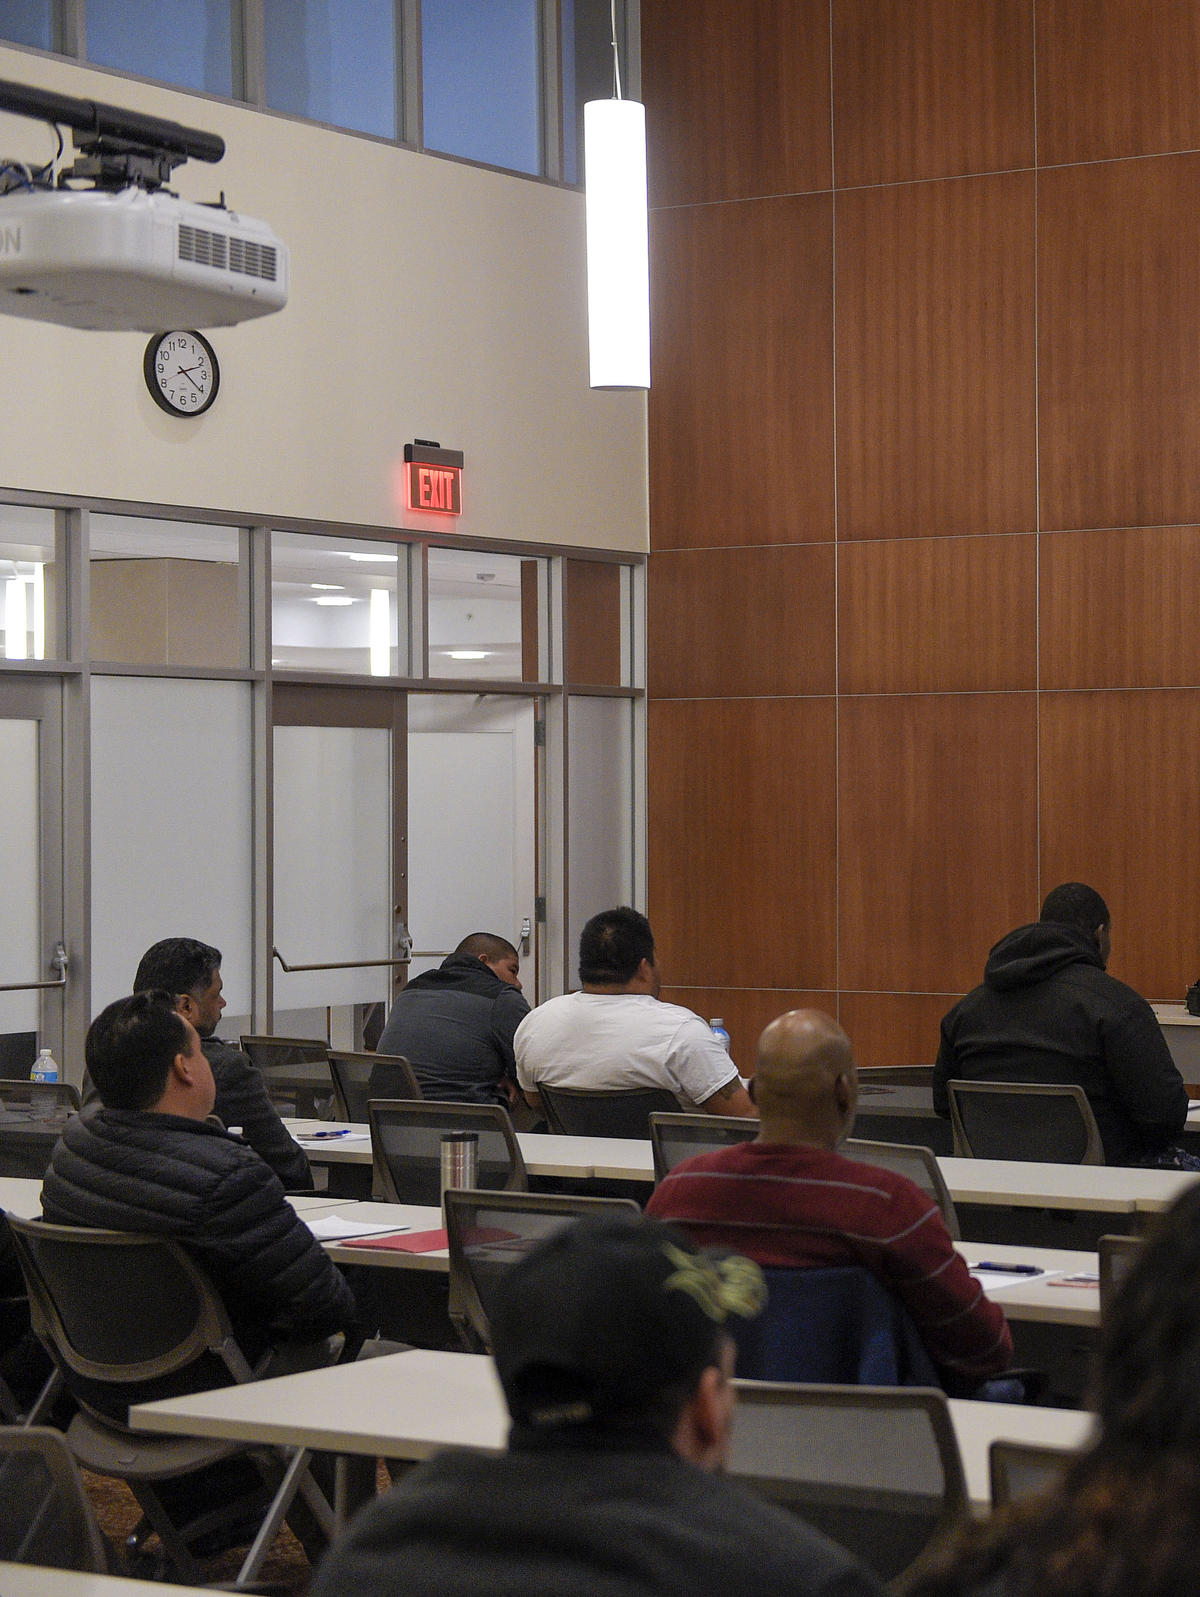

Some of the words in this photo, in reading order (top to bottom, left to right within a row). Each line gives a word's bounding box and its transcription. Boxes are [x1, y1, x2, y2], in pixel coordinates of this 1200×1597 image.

[0, 227, 21, 253] N
[168, 341, 175, 351] 11
[177, 338, 186, 348] 12
[191, 345, 195, 354] 1
[160, 350, 170, 361] 10
[198, 356, 204, 366] 2
[157, 363, 164, 373] 9
[201, 370, 207, 380] 3
[161, 378, 167, 388] 8
[169, 389, 175, 399] 7
[199, 384, 204, 394] 4
[180, 395, 187, 405] 6
[191, 393, 197, 403] 5
[418, 468, 454, 510] EXIT
